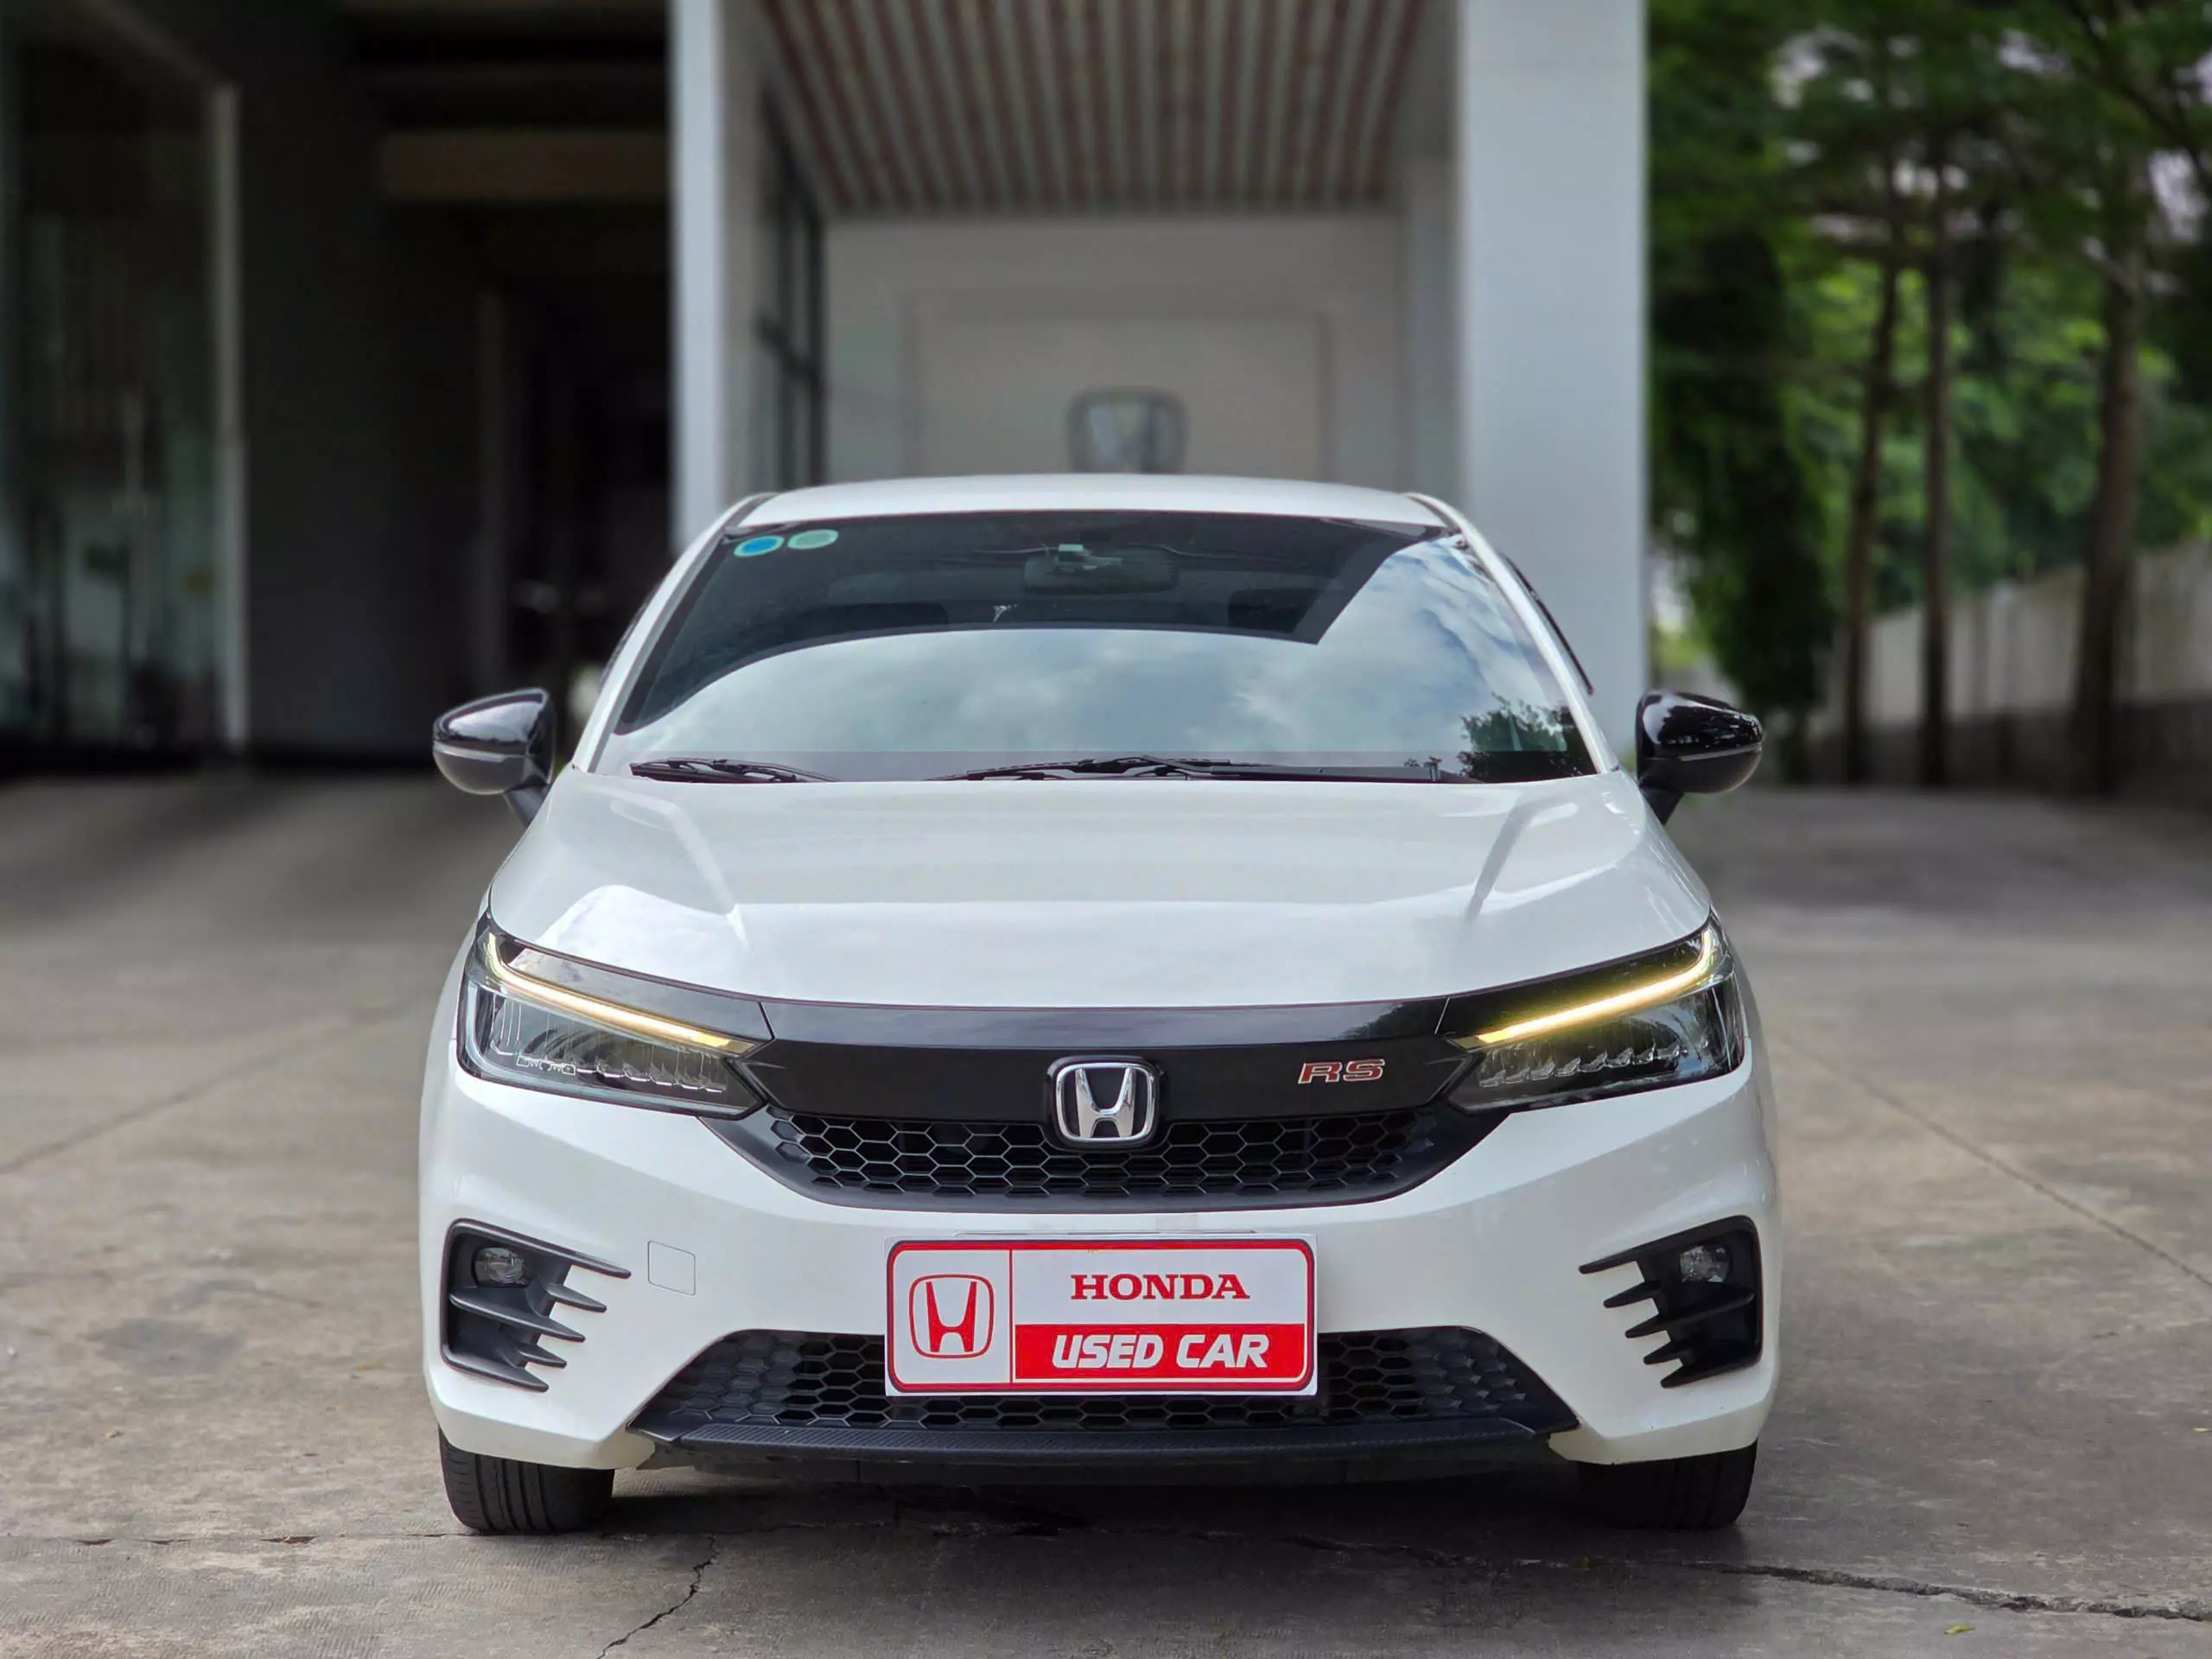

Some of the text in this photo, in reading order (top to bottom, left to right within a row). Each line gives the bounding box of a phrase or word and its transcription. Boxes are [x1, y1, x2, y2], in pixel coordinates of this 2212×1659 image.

[1298, 1058, 1385, 1084] RS
[1071, 1274, 1250, 1300] HONDA
[1052, 1334, 1269, 1369] USED CAR
